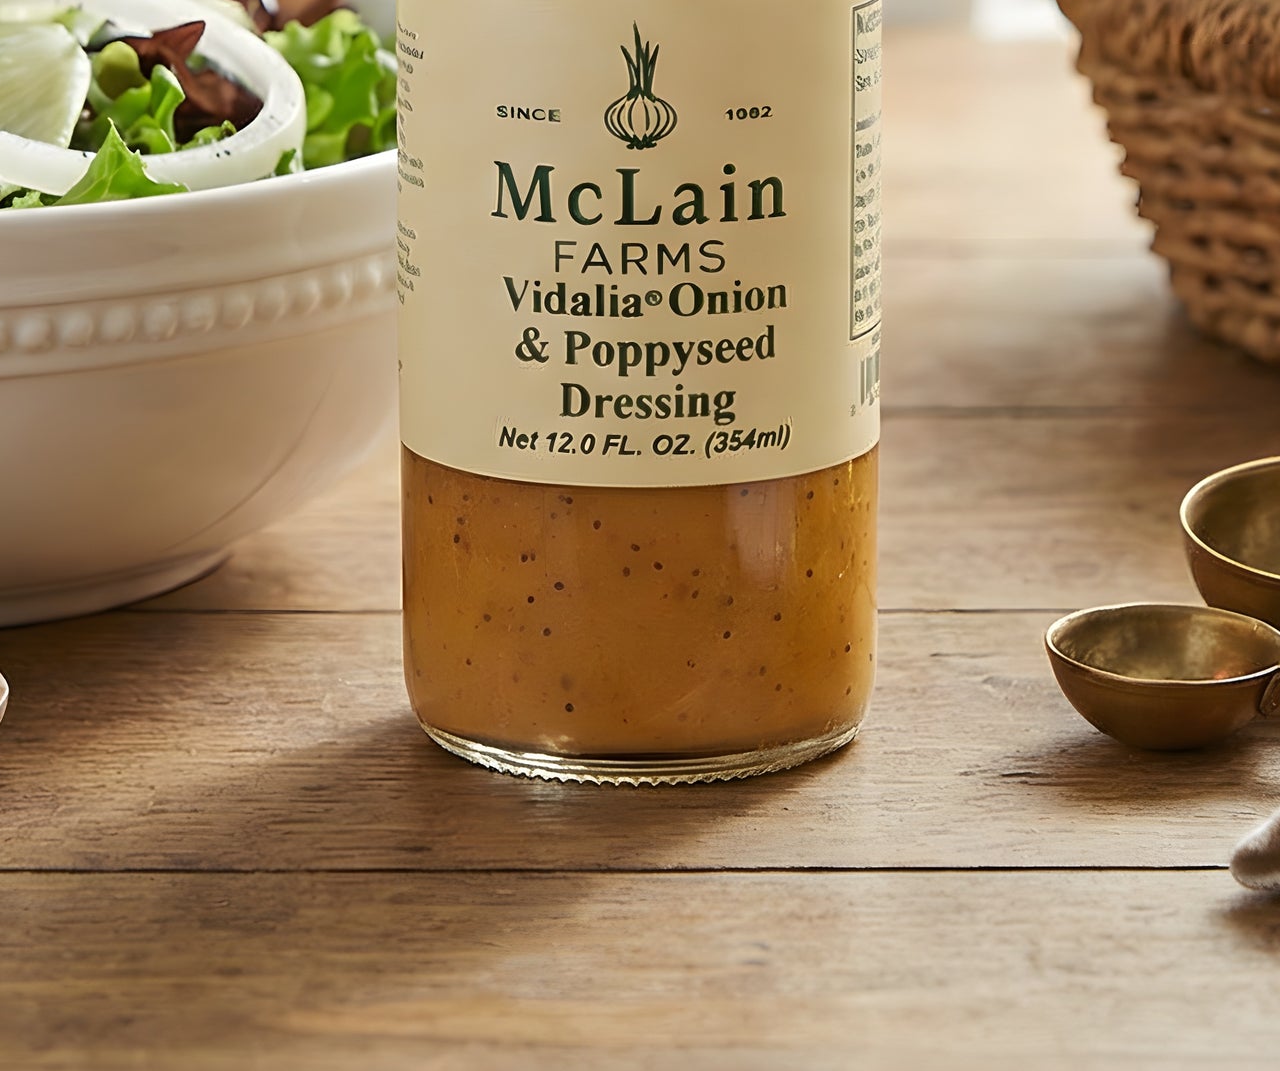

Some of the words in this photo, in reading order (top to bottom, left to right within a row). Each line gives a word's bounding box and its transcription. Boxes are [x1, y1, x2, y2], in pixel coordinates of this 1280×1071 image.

[497, 105, 561, 123] SINCE
[491, 160, 787, 226] McLain
[555, 239, 726, 275] FARMS
[669, 280, 787, 316] Onion
[515, 326, 550, 363] &
[564, 325, 776, 377] Poppyseed
[559, 382, 736, 426] Dressing
[499, 426, 538, 450] Net
[546, 432, 596, 455] 12.0
[602, 434, 642, 456] FL.
[652, 434, 695, 455] OZ.
[705, 424, 791, 459] (354ml)
